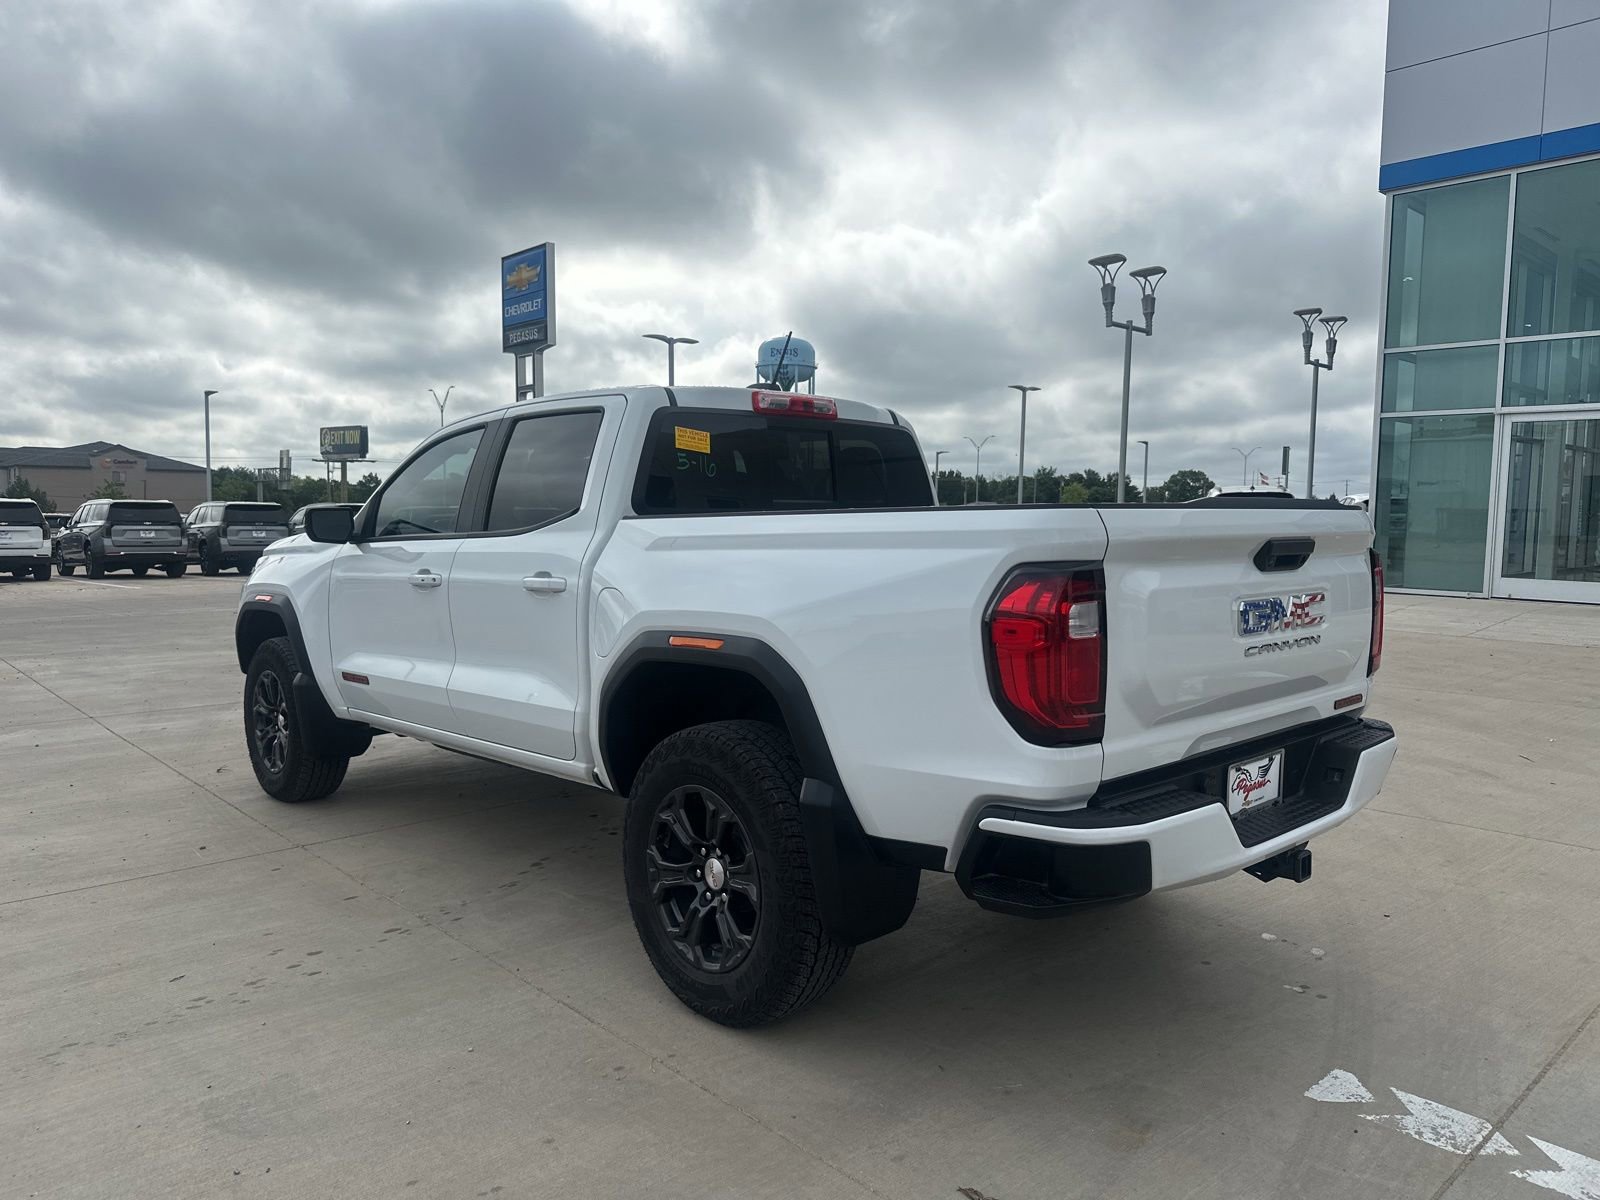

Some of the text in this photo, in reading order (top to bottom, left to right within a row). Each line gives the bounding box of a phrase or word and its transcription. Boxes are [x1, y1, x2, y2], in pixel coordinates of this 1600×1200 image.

[504, 298, 542, 317] CHEVROLET
[509, 328, 538, 343] PEGASUS
[330, 429, 360, 445] EXIT NOW
[1238, 593, 1326, 637] GMC
[1244, 635, 1321, 657] CANYON
